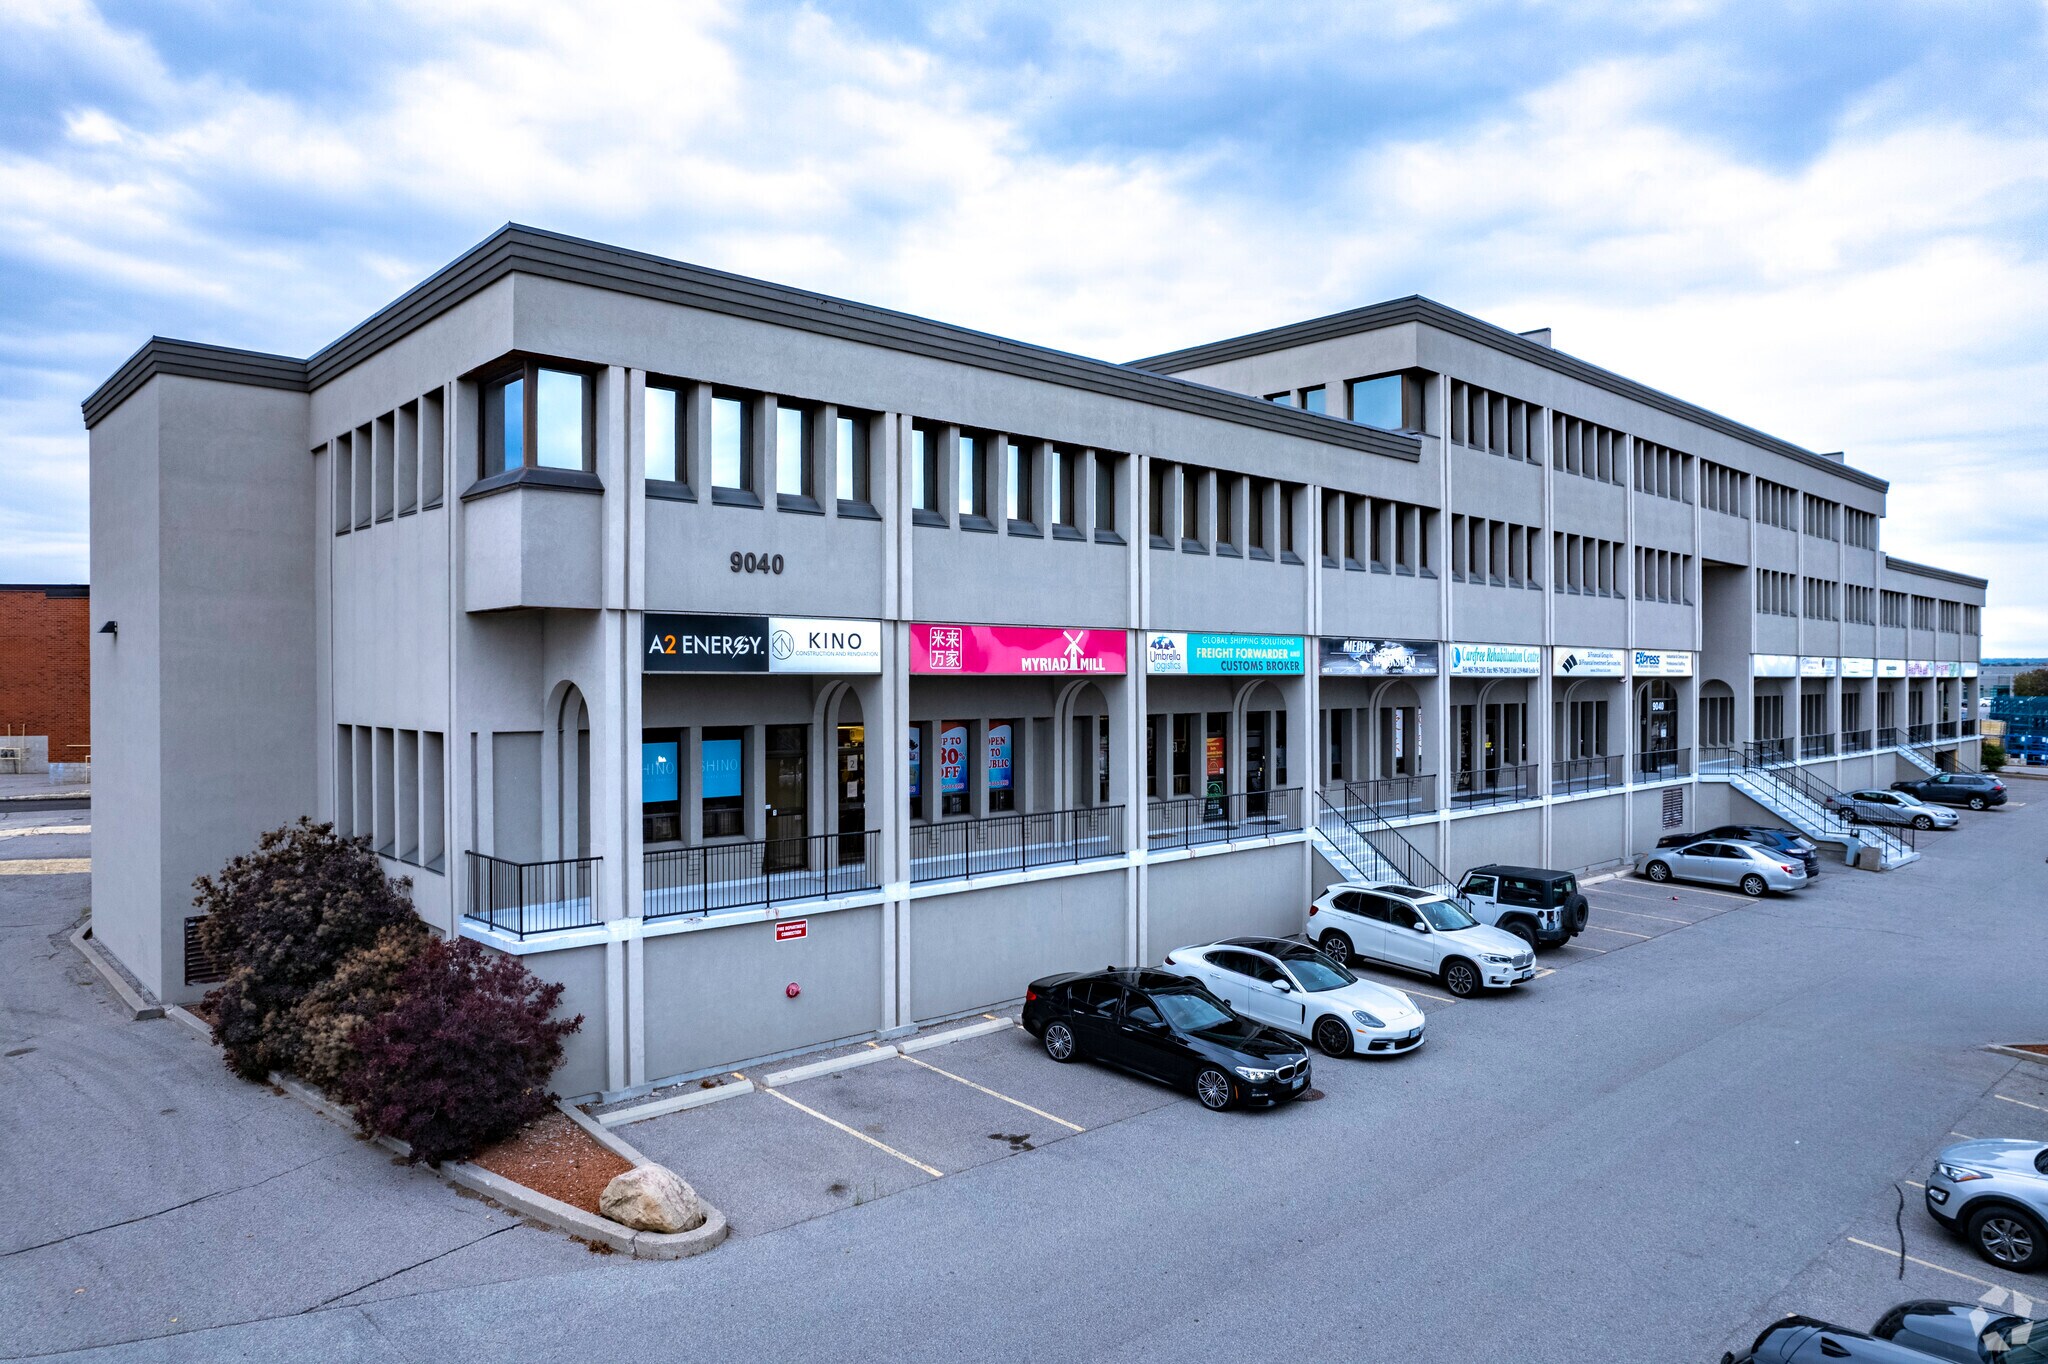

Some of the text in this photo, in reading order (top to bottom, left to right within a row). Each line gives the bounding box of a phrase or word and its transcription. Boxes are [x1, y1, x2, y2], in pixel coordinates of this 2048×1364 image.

[730, 551, 784, 575] 9040
[649, 634, 677, 654] A2
[809, 632, 862, 649] KINO
[1202, 636, 1295, 646] GLOBAL SHIPPING SOLUTIONS
[1343, 640, 1371, 653] MEDIA
[1149, 650, 1181, 663] Umbrella
[1196, 647, 1233, 659] FREIGHT
[1235, 648, 1288, 659] FORWARDER
[1462, 646, 1539, 665] Carefree Rehabilitation Centre
[1021, 657, 1105, 672] MYRIAD MILL
[1153, 660, 1182, 672] Logistics
[1220, 660, 1300, 671] CUSTOMS BROKER
[1652, 701, 1664, 711] 9040
[950, 737, 962, 745] TO
[988, 736, 1006, 746] PEN
[990, 748, 1001, 757] TO
[850, 760, 855, 768] 2
[941, 766, 960, 778] FF
